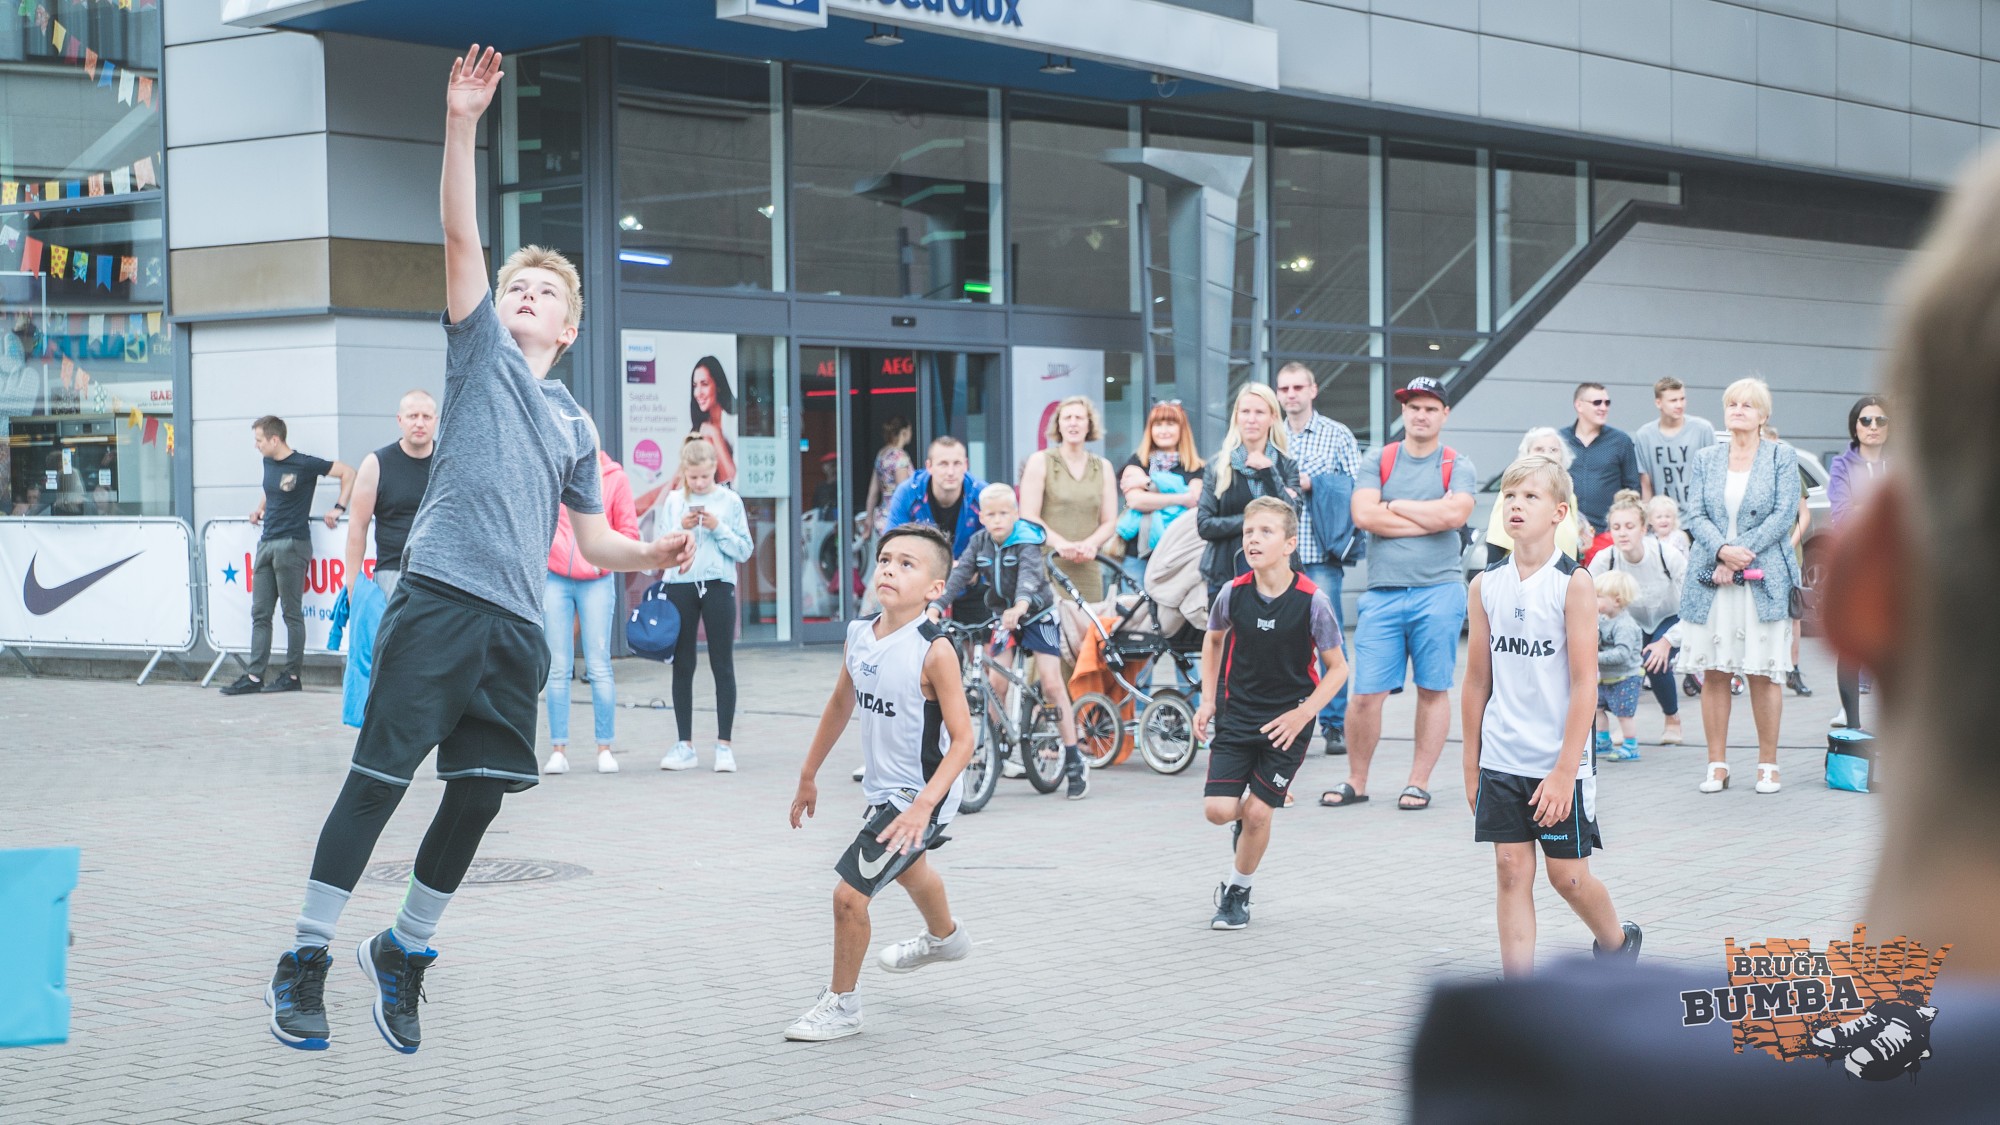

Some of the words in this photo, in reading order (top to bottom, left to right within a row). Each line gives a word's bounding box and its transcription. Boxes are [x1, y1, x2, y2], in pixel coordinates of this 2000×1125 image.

[817, 360, 836, 377] AE
[881, 356, 914, 375] AEG
[1655, 446, 1688, 464] FLY
[1663, 466, 1684, 484] BY
[854, 688, 896, 717] NDAS
[1541, 834, 1568, 842] uhlsport
